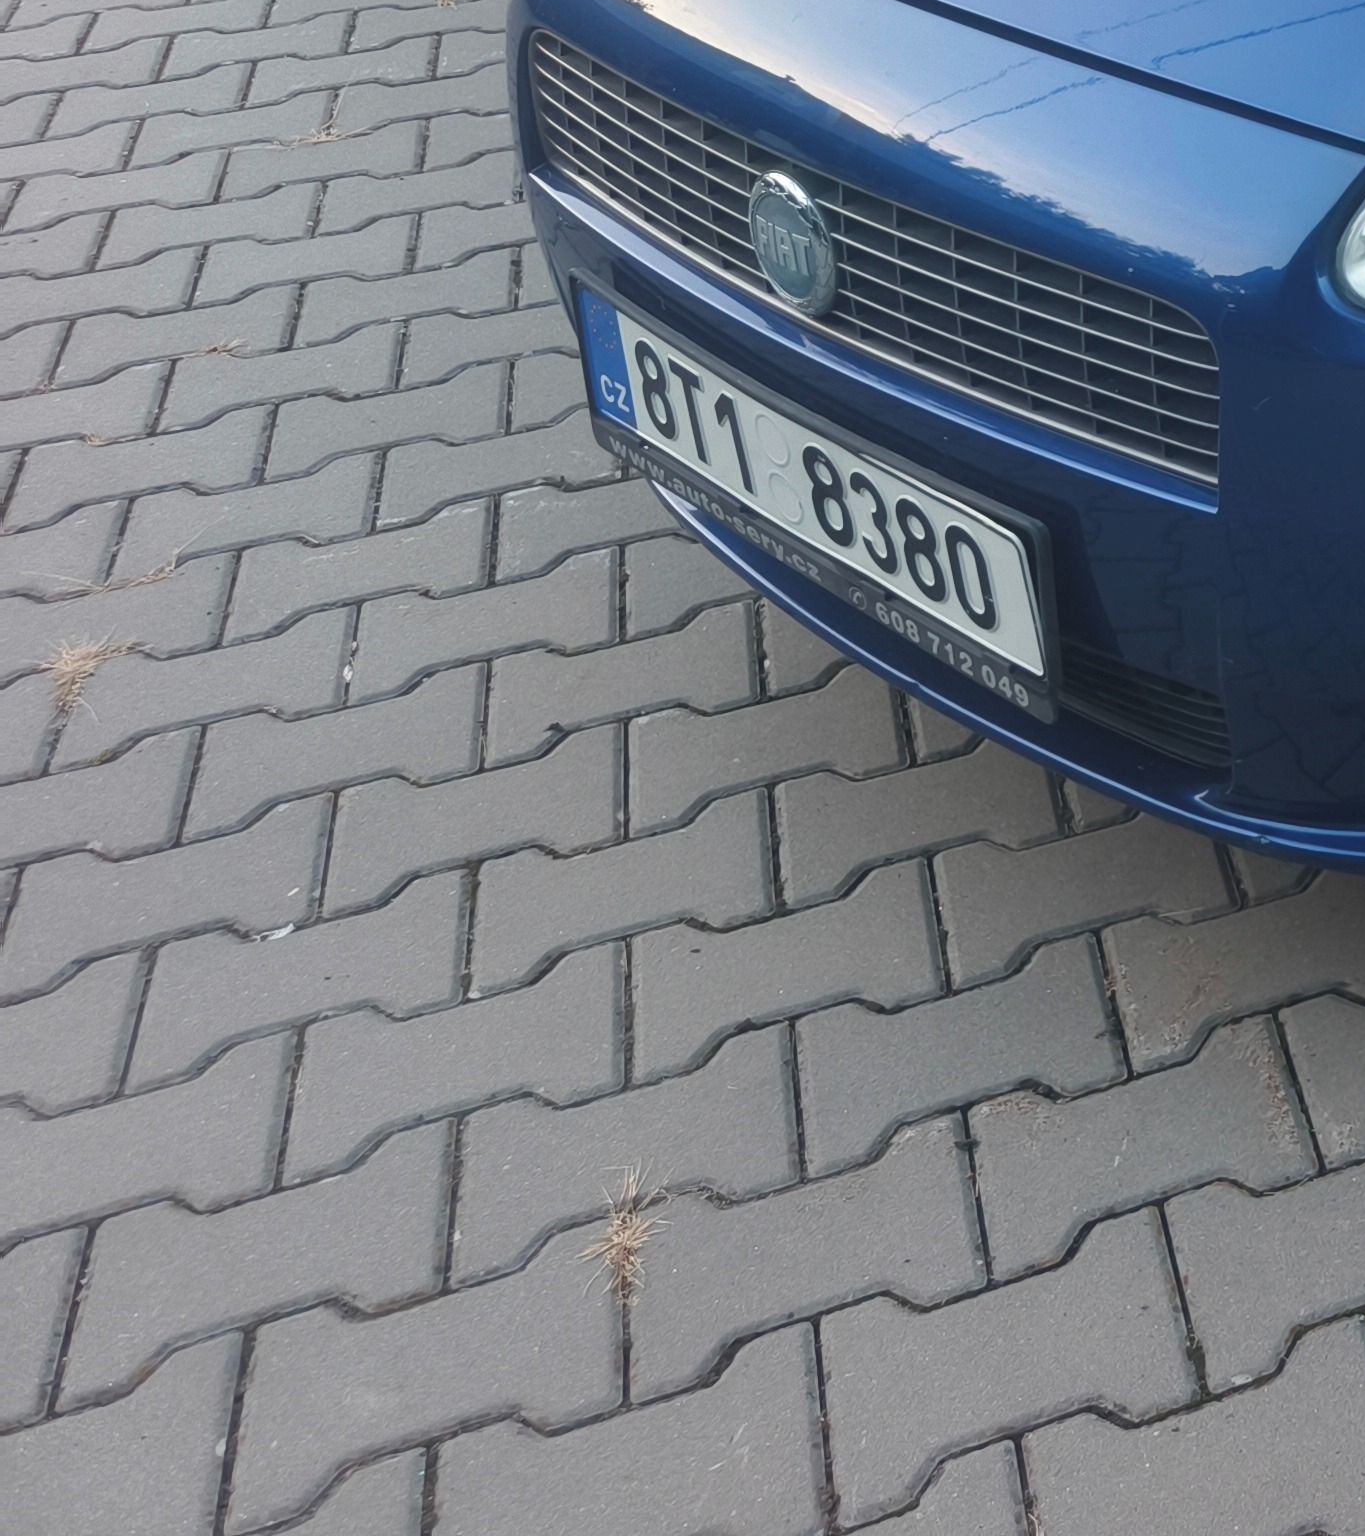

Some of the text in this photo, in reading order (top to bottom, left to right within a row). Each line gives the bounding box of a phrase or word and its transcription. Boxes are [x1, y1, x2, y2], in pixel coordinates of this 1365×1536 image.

[755, 214, 811, 276] FIAT
[599, 374, 631, 414] CZ
[634, 338, 999, 631] 8T1 8380
[875, 602, 921, 644] 608
[927, 631, 975, 676] 712
[981, 664, 1030, 708] 049
